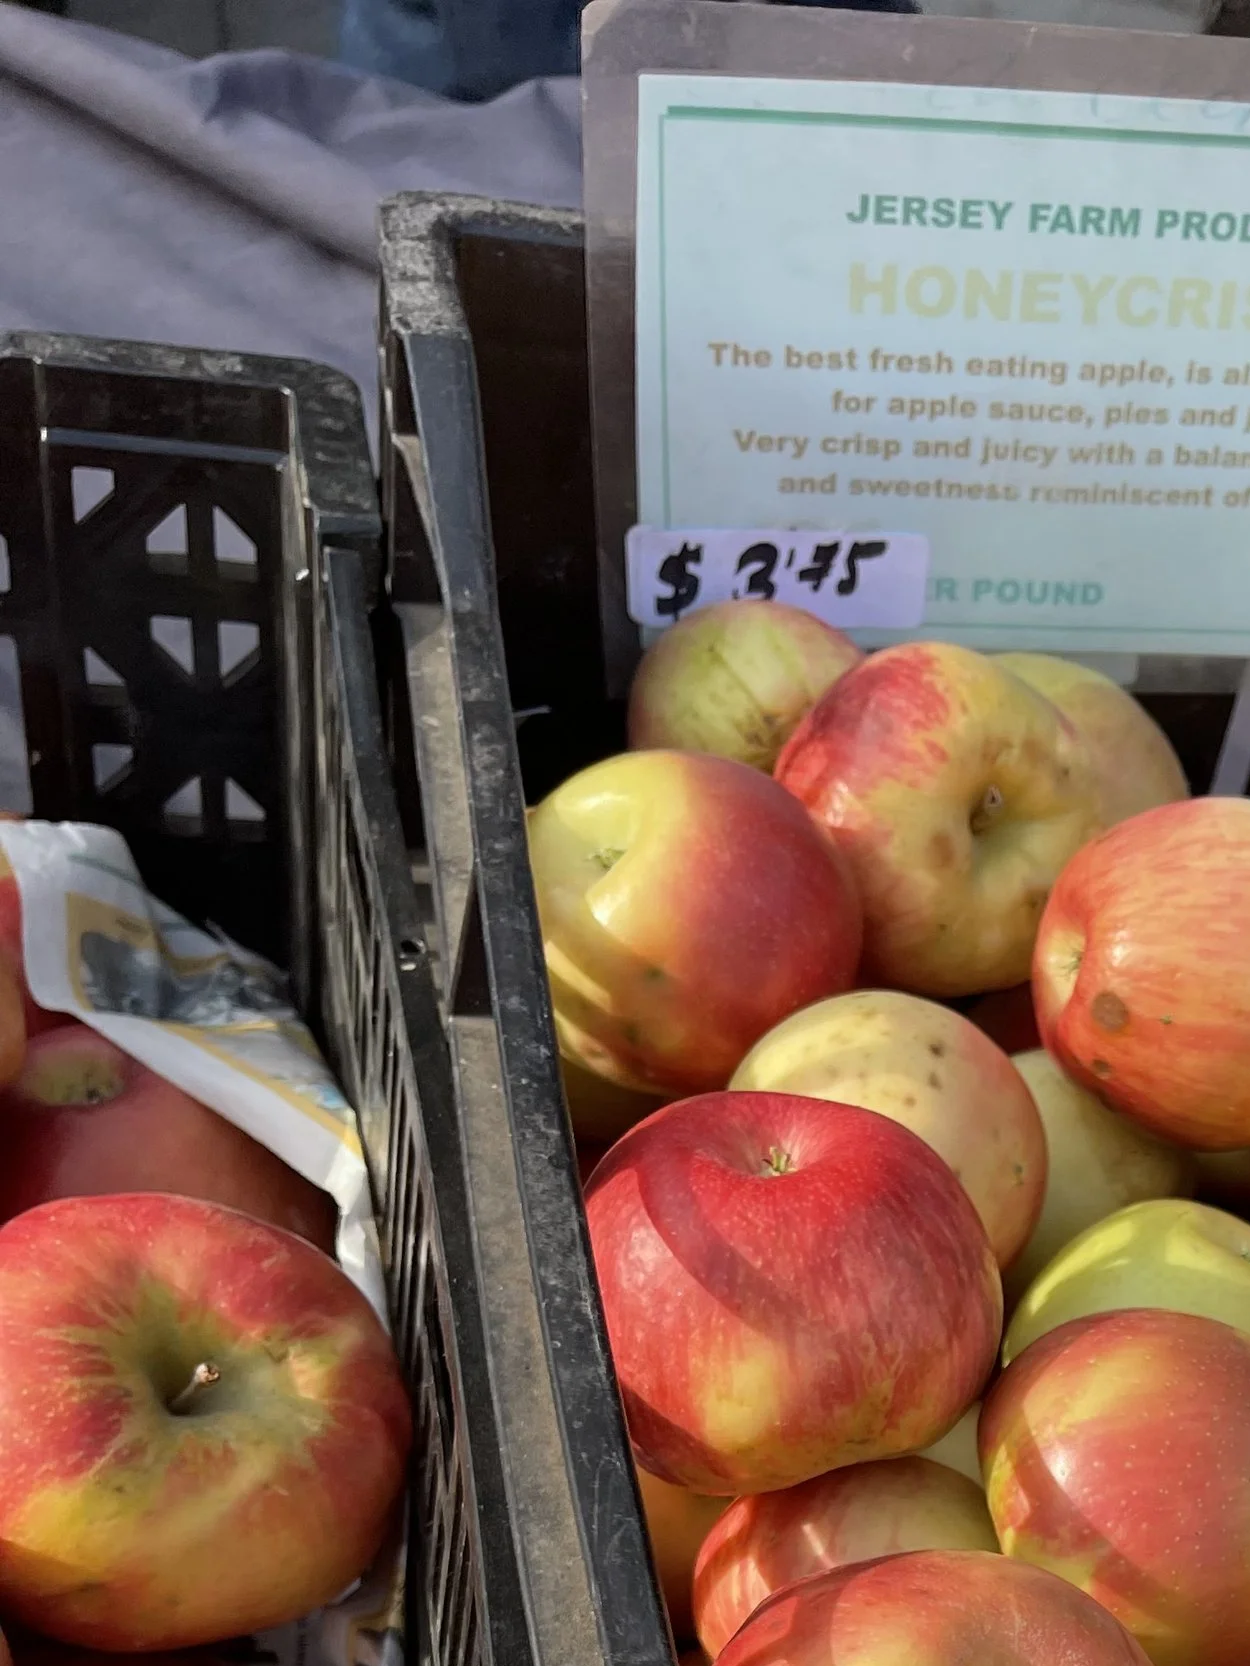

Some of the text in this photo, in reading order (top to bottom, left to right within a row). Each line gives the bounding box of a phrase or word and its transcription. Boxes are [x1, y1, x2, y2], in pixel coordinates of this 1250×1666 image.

[846, 193, 1013, 231] JERSEY
[1028, 204, 1141, 239] FARM
[708, 342, 772, 368] The
[784, 344, 857, 371] best
[870, 348, 953, 375] fresh
[965, 355, 1067, 385] eating
[1078, 359, 1174, 388] apple,
[1185, 360, 1212, 384] is
[832, 389, 878, 414] for
[887, 394, 977, 421] apple
[988, 401, 1093, 428] sauce,
[1105, 402, 1169, 428] pies
[1179, 405, 1237, 428] and
[734, 429, 809, 459] Very
[820, 432, 901, 461] crisp
[913, 436, 971, 459] and
[980, 437, 1058, 468] juicy
[1068, 442, 1134, 466] with
[1146, 447, 1163, 467] a
[778, 472, 837, 495] and
[849, 477, 1020, 502] sweetness
[1030, 482, 1213, 508] reminiscent
[972, 577, 1104, 606] POUND
